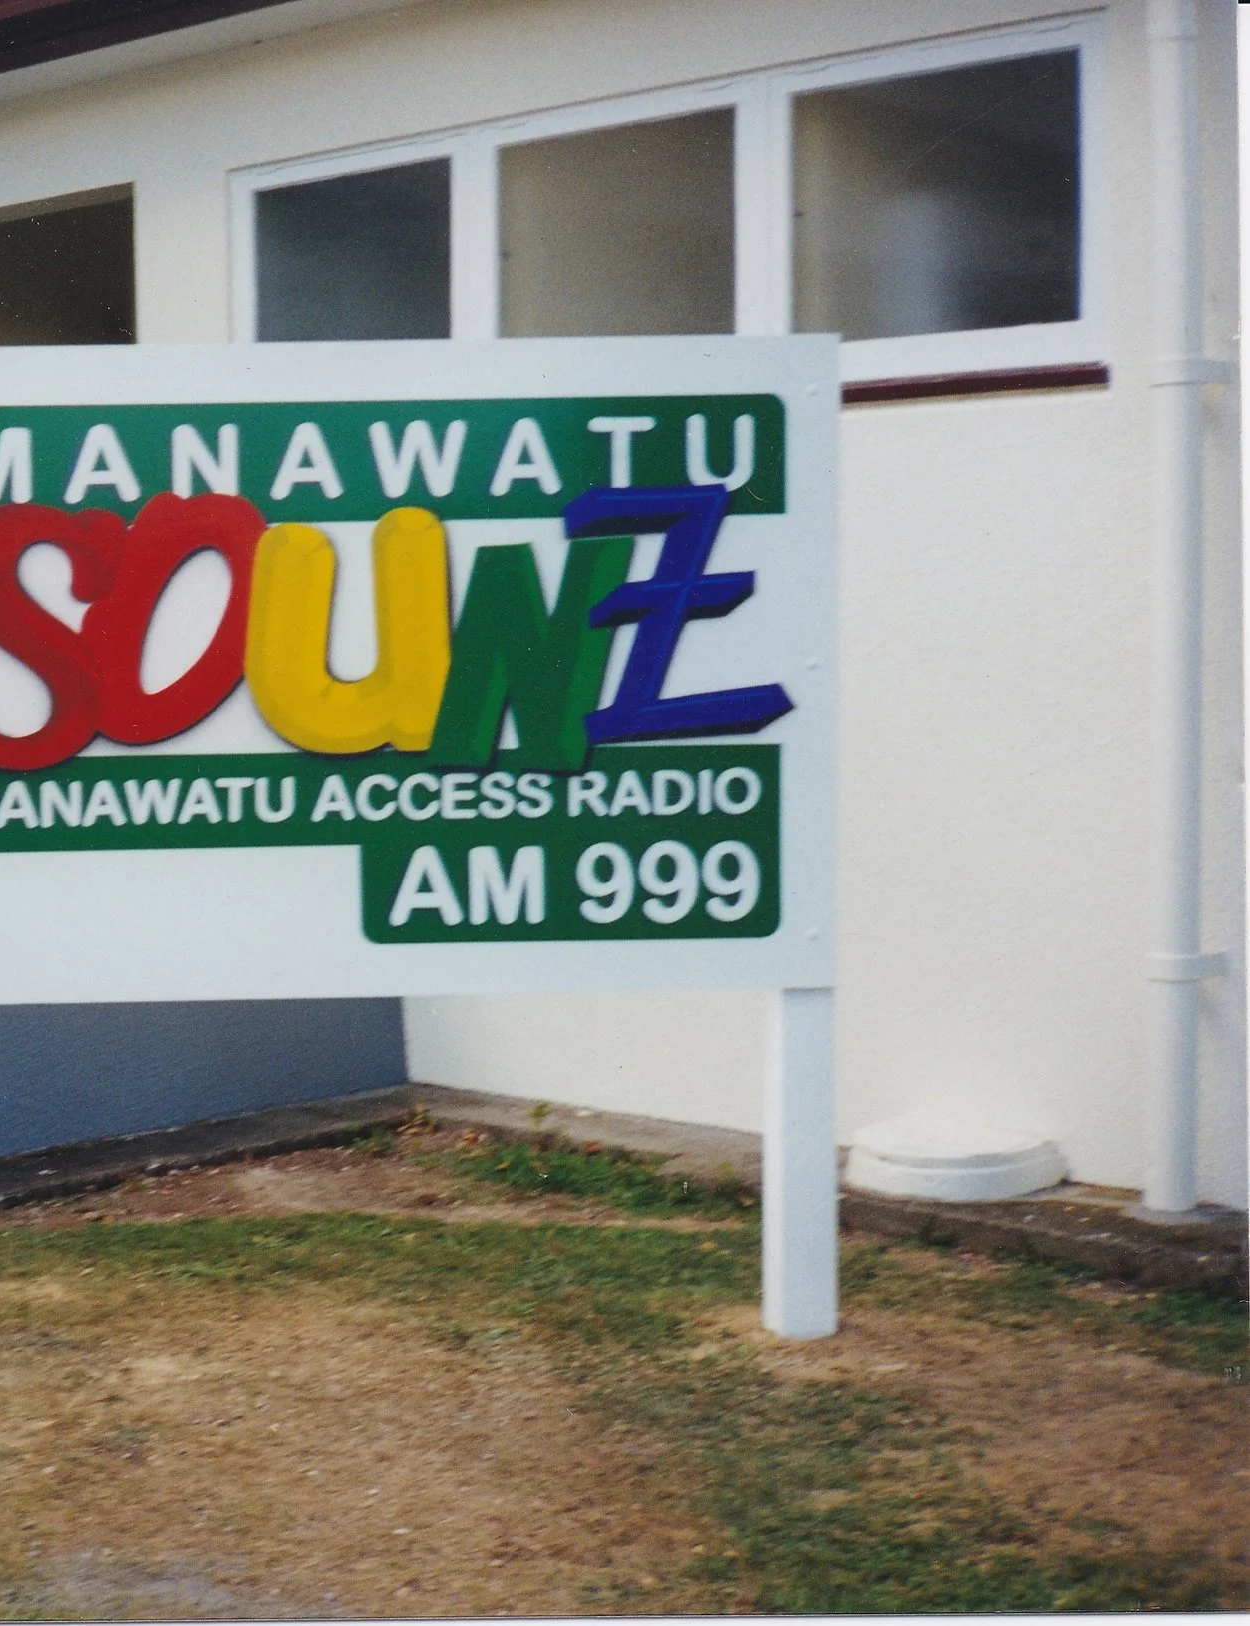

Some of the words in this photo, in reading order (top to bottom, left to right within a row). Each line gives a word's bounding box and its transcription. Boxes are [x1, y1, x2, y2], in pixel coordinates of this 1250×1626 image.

[311, 771, 551, 821] ACCESS
[566, 764, 762, 818] RADIO
[388, 844, 546, 927] AM
[575, 839, 761, 924] 999
